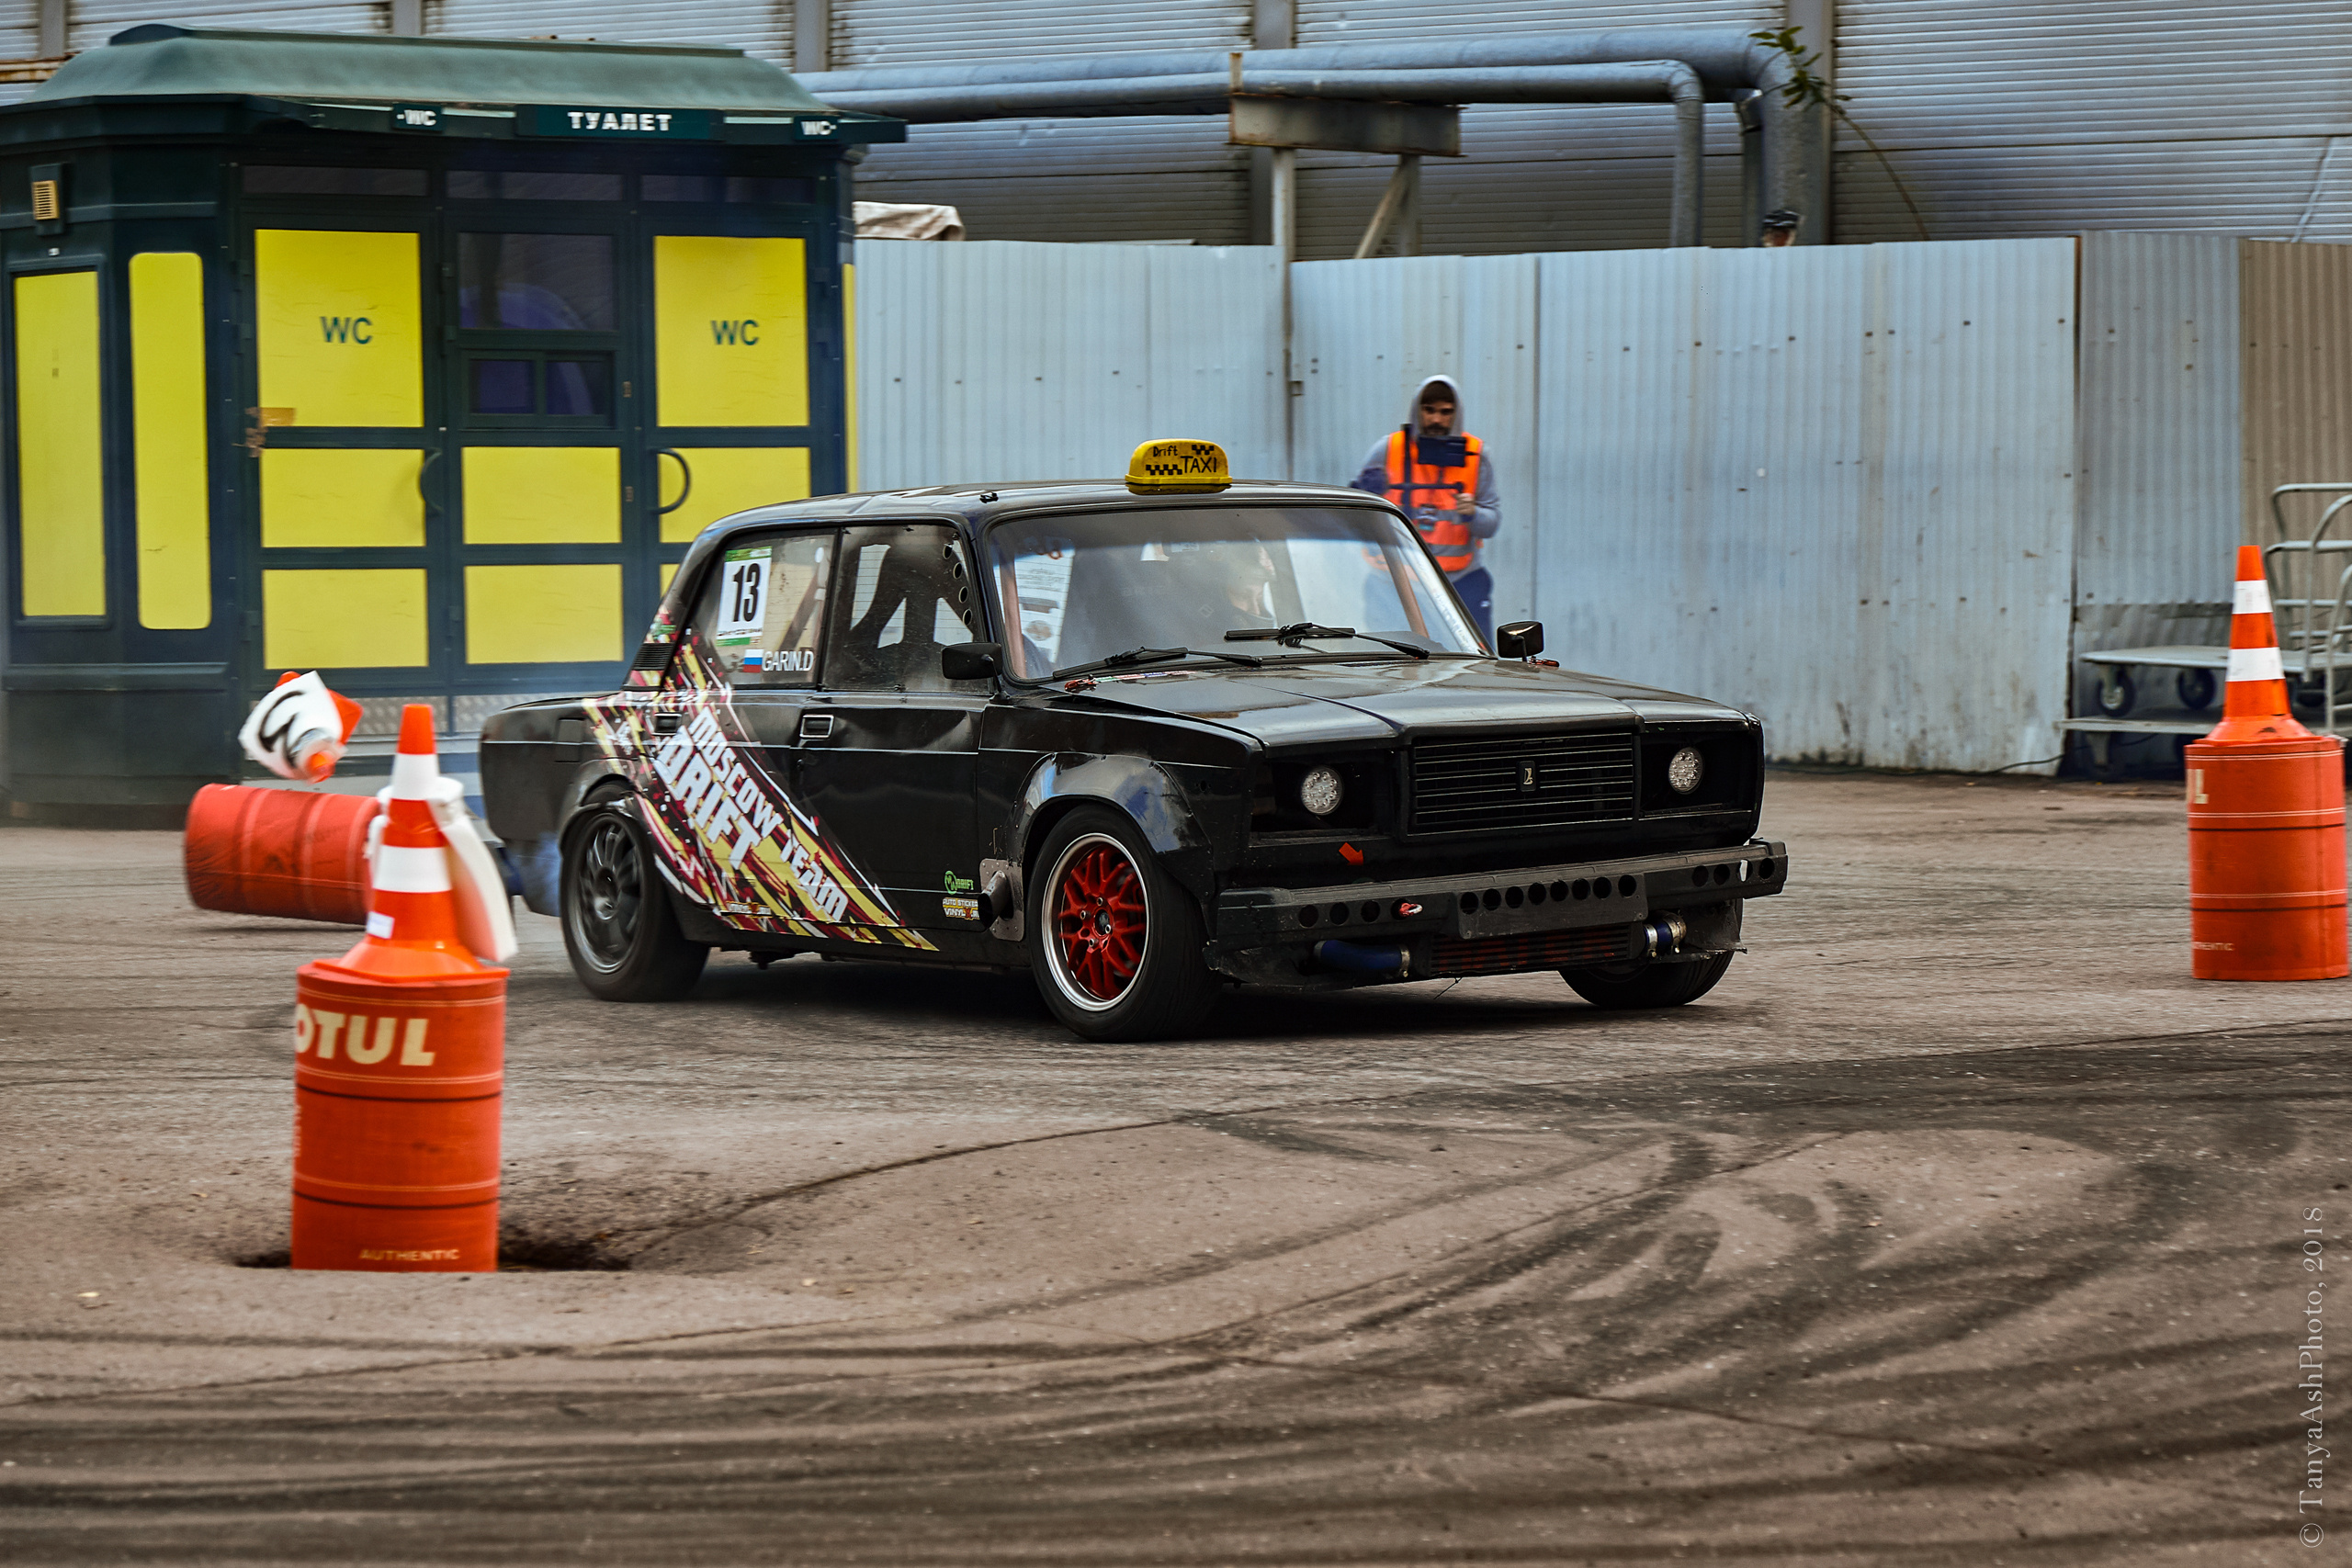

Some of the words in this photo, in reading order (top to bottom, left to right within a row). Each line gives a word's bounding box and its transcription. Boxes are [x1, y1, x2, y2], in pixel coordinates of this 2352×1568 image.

[567, 110, 673, 132] ТУАЛЕТ
[319, 316, 374, 345] WC
[710, 319, 760, 346] WC
[1153, 446, 1178, 457] Drift
[1181, 456, 1217, 473] TAXI
[731, 562, 762, 623] 13
[652, 725, 763, 871] DRIFT
[689, 705, 784, 840] MOSCOW
[780, 829, 849, 922] TEAM
[358, 1248, 460, 1262] AUTHENTIC
